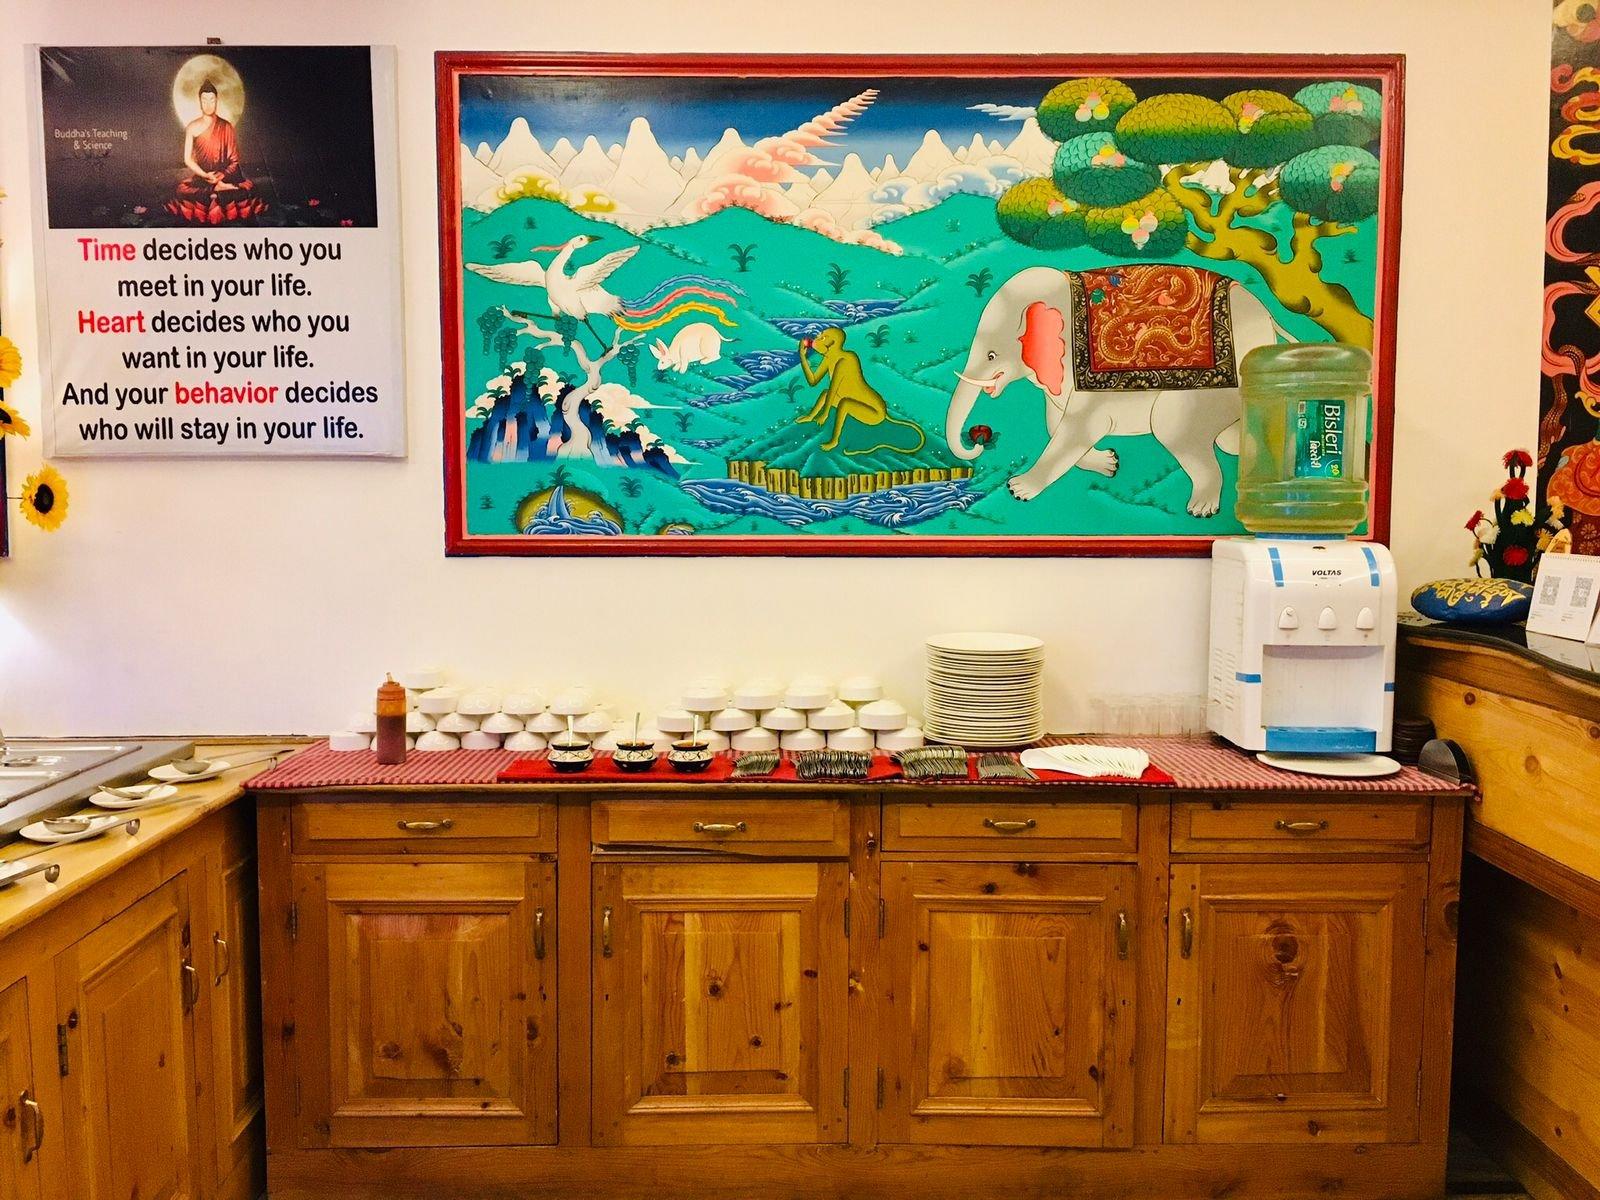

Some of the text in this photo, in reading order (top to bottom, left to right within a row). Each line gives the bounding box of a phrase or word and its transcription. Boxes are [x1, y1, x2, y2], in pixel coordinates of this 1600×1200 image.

[54, 128, 128, 140] Buddha's Teaching
[73, 140, 112, 150] & Science
[78, 237, 341, 266] Time decides who you
[118, 273, 311, 302] meet in your life.
[78, 309, 349, 338] Heart decides who you
[122, 345, 313, 374] want in your life.
[63, 381, 378, 410] And your behavior decides
[79, 416, 363, 445] who will stay in your life.
[1324, 405, 1342, 455] Bisleri
